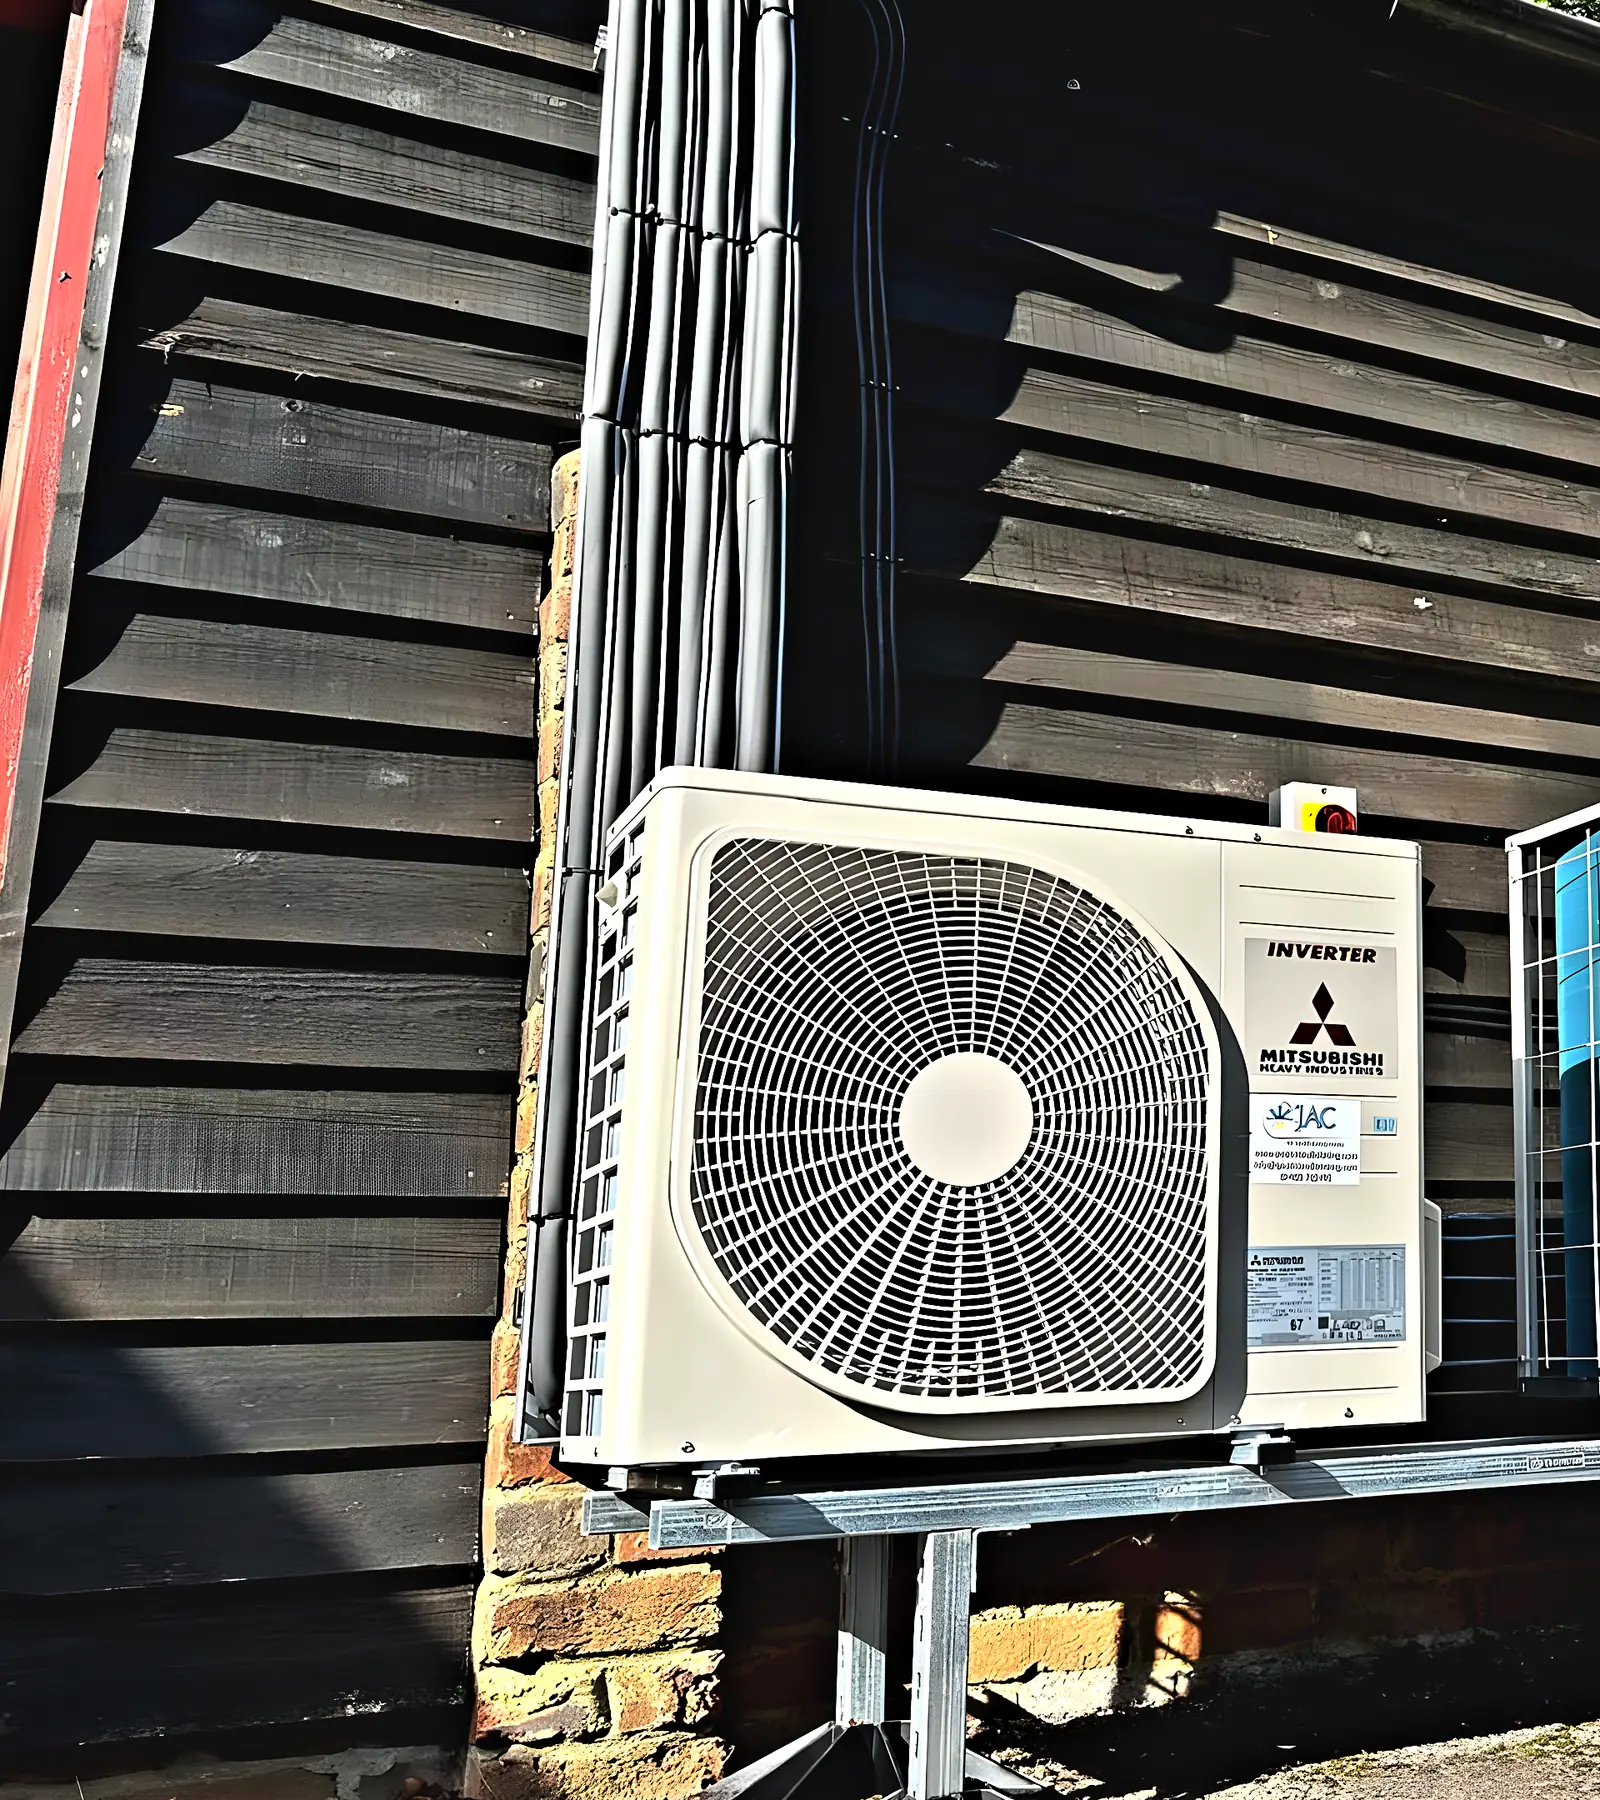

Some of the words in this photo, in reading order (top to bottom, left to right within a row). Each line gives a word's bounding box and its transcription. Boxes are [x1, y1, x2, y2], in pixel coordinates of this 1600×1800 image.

[1267, 942, 1377, 963] INVERTER
[1260, 1049, 1384, 1067] MITSUBISHI
[1259, 1064, 1302, 1073] HEAVY
[1295, 1105, 1337, 1132] JAC
